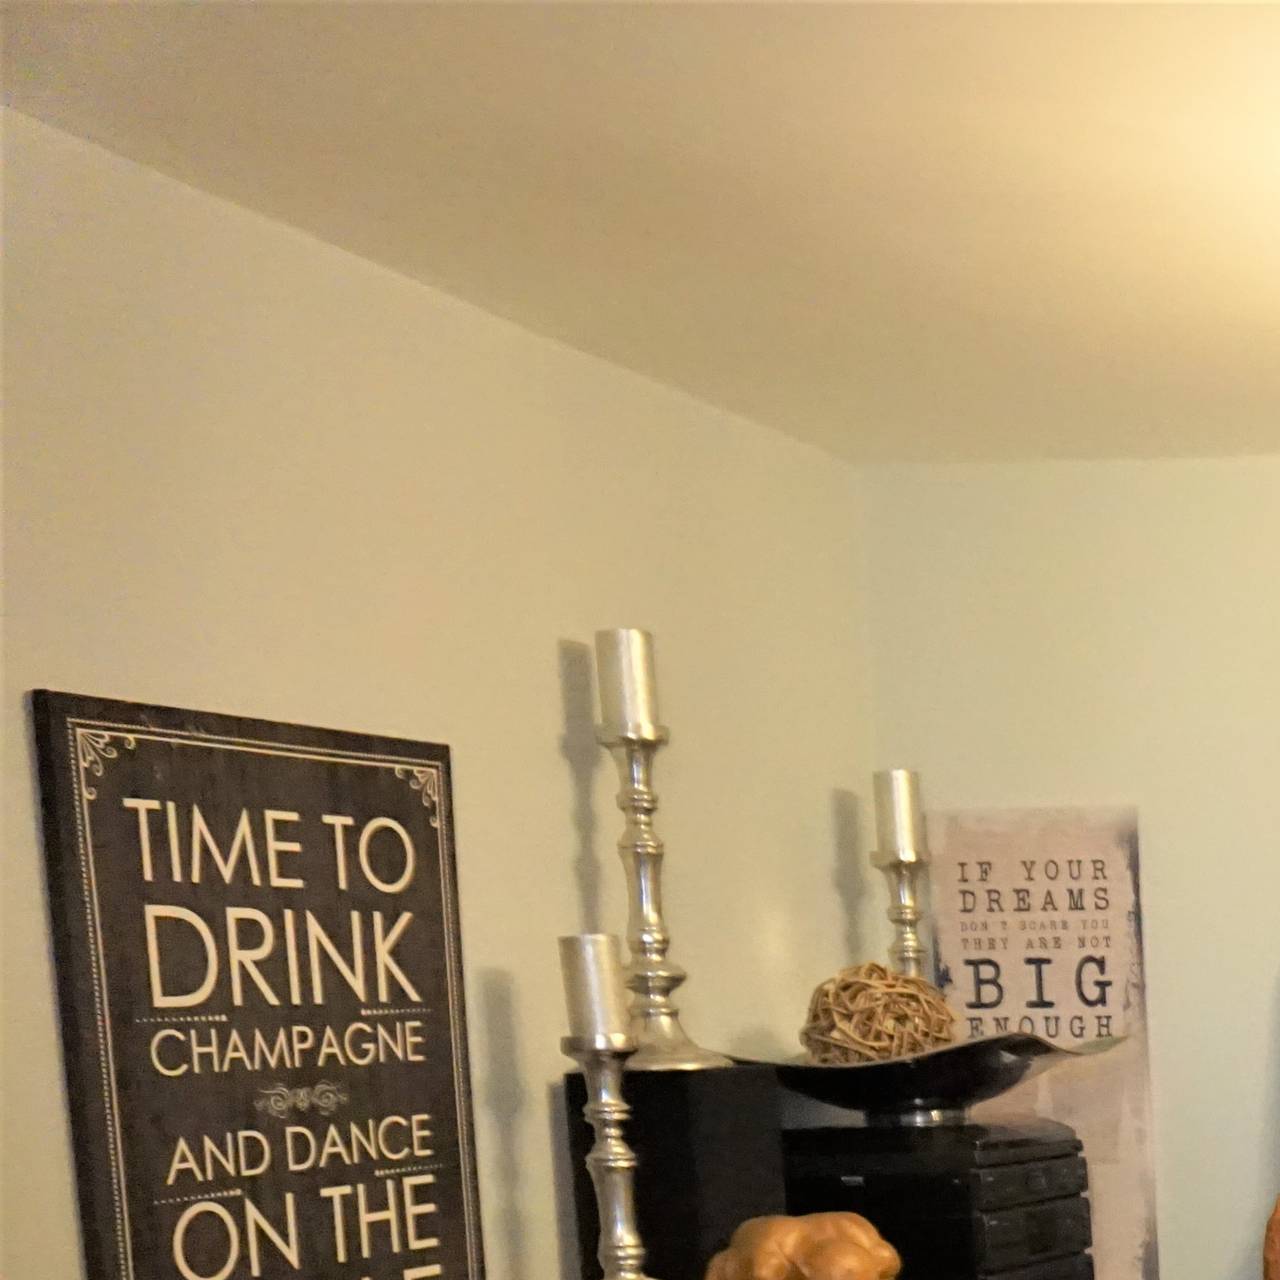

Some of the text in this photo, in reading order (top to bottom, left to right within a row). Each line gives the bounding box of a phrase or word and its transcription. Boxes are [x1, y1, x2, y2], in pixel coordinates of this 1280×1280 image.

[122, 797, 416, 894] TIME TO
[957, 859, 1108, 882] IF YOUR
[958, 886, 1110, 913] DREAMS
[960, 919, 1110, 931] DONT SCARE YOU
[143, 904, 422, 1009] DRINK
[961, 935, 1111, 950] THEY ARE NOT
[963, 955, 1112, 1009] BIG
[150, 1021, 426, 1077] CHAMPAGNE
[966, 1015, 1112, 1039] ENOUGH
[167, 1114, 433, 1186] AND DANCE
[320, 1174, 439, 1263] THE
